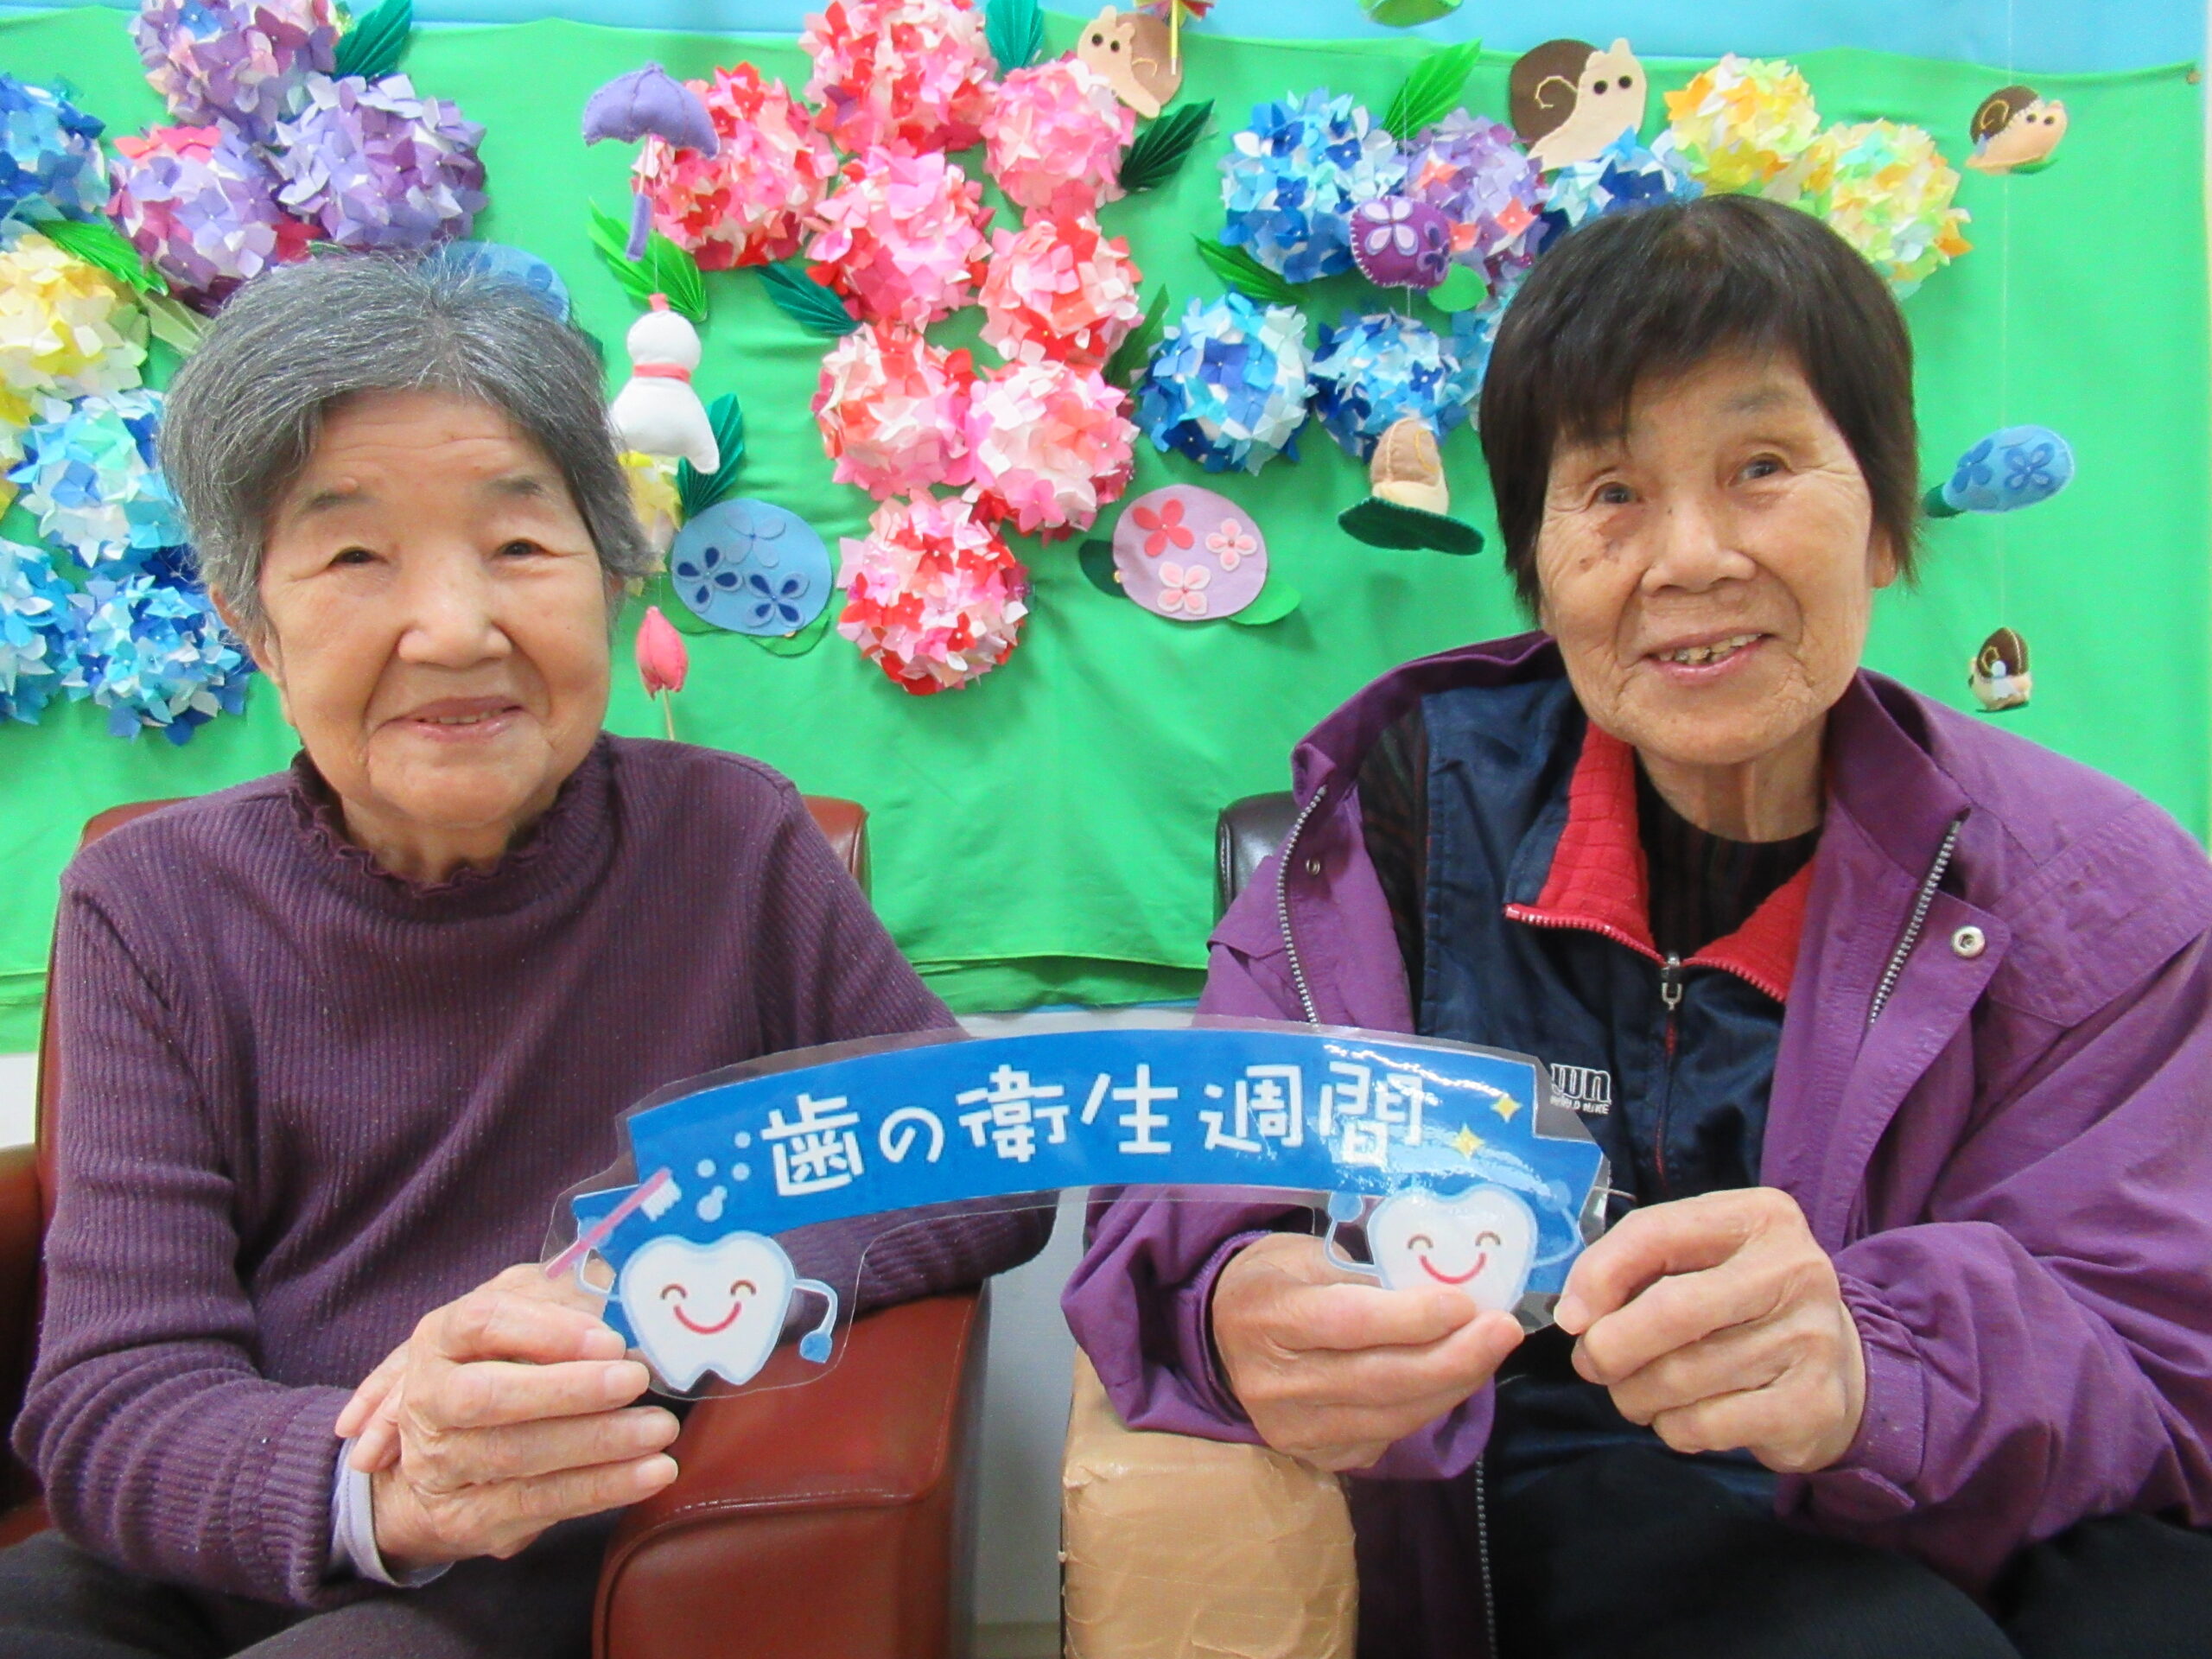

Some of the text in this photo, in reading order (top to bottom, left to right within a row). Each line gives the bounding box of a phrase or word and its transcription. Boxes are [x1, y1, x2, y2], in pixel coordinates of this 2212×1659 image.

[760, 1060, 1426, 1198] 歯の衛生週間
